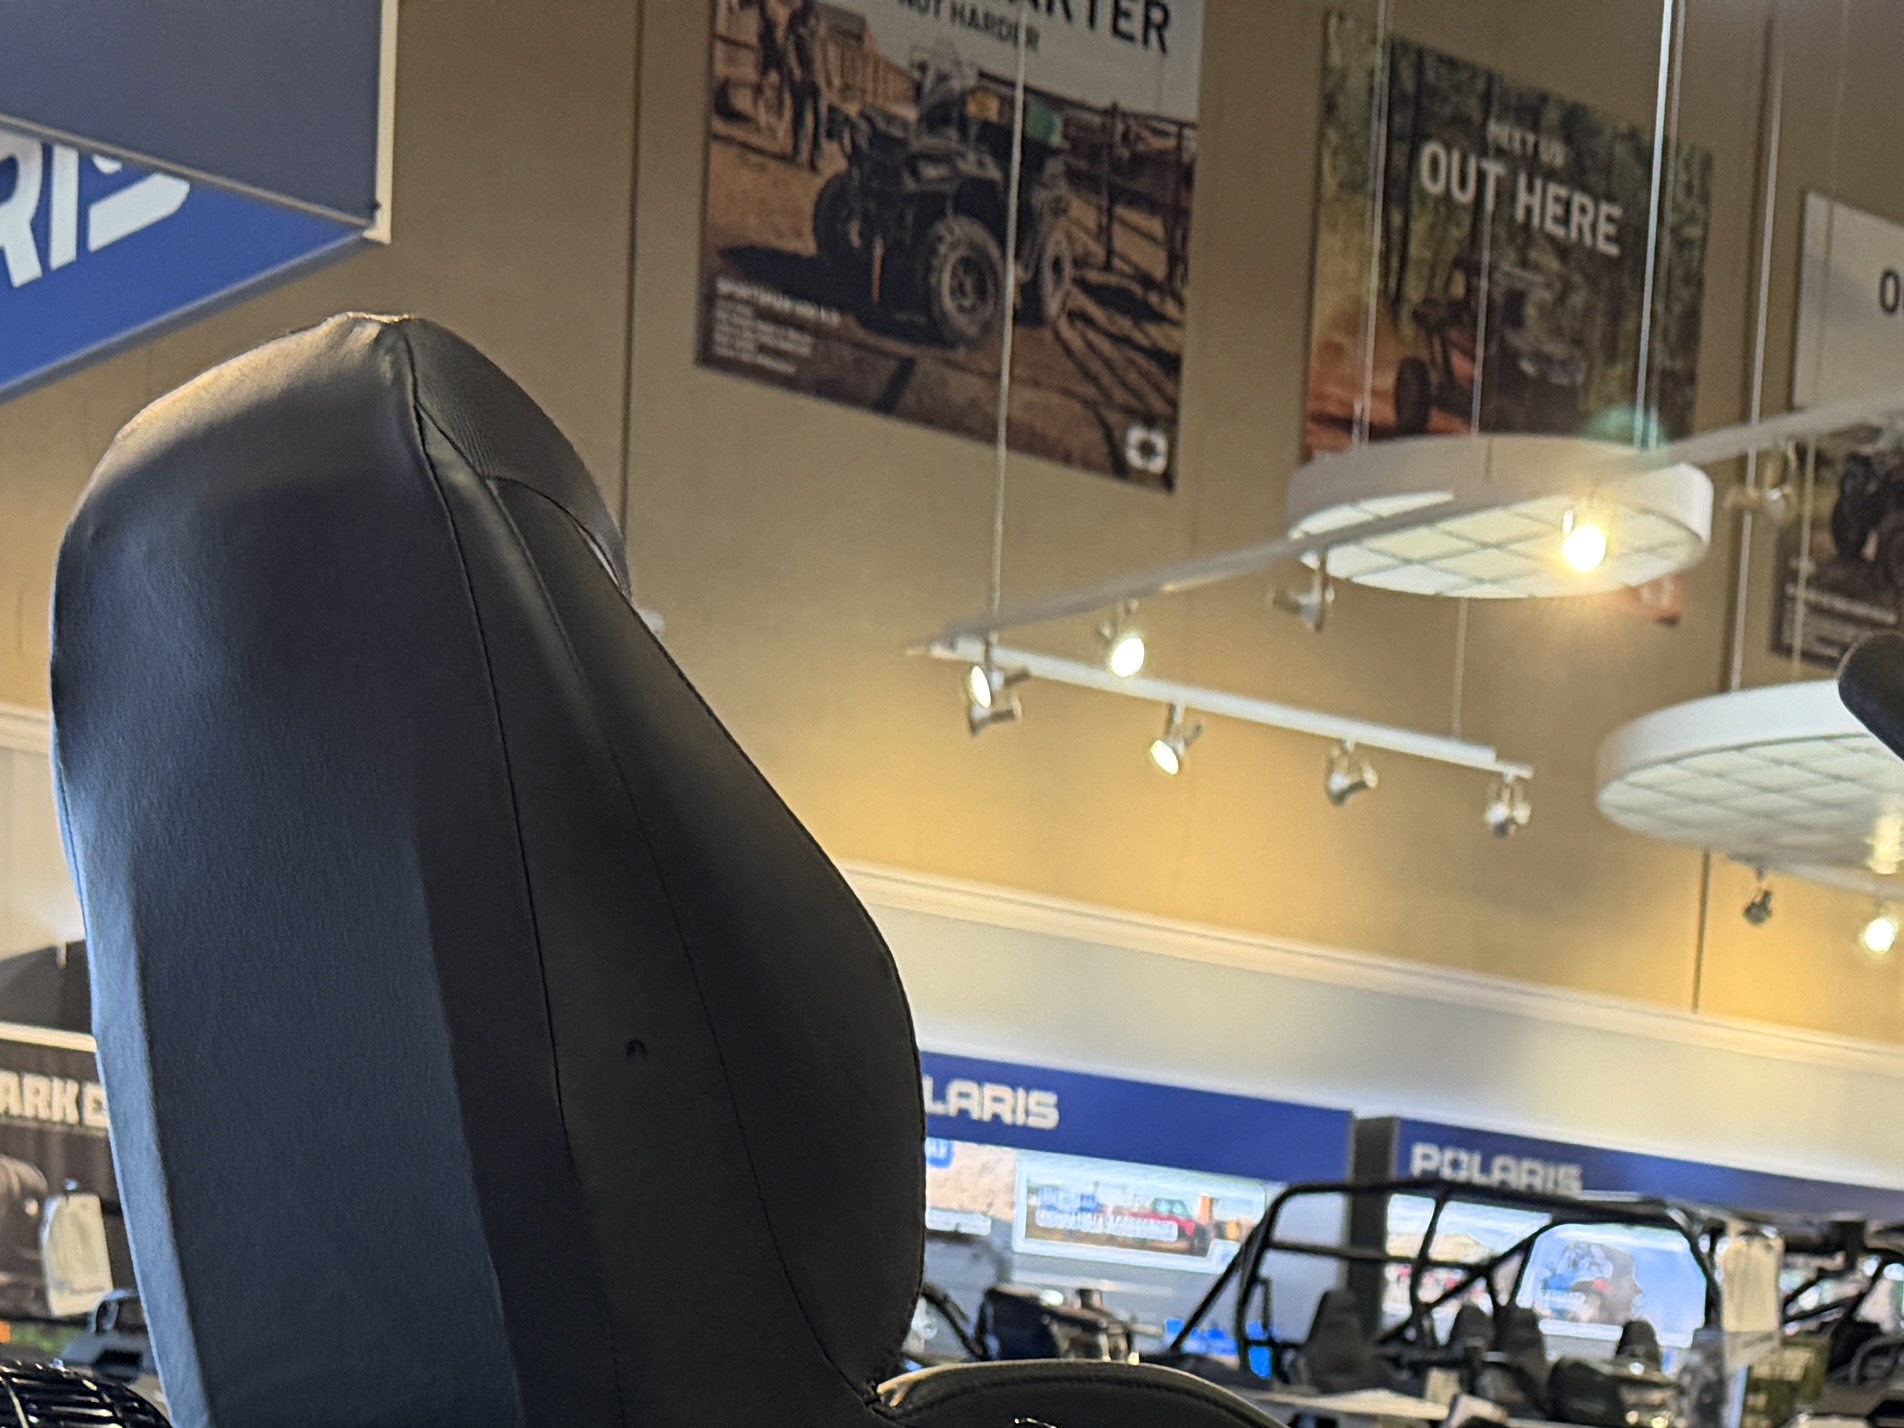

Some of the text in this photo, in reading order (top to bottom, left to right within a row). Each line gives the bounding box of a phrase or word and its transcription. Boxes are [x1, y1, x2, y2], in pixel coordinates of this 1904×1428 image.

[1420, 140, 1624, 259] OUT HERE
[1410, 1142, 1585, 1200] POLARIS
